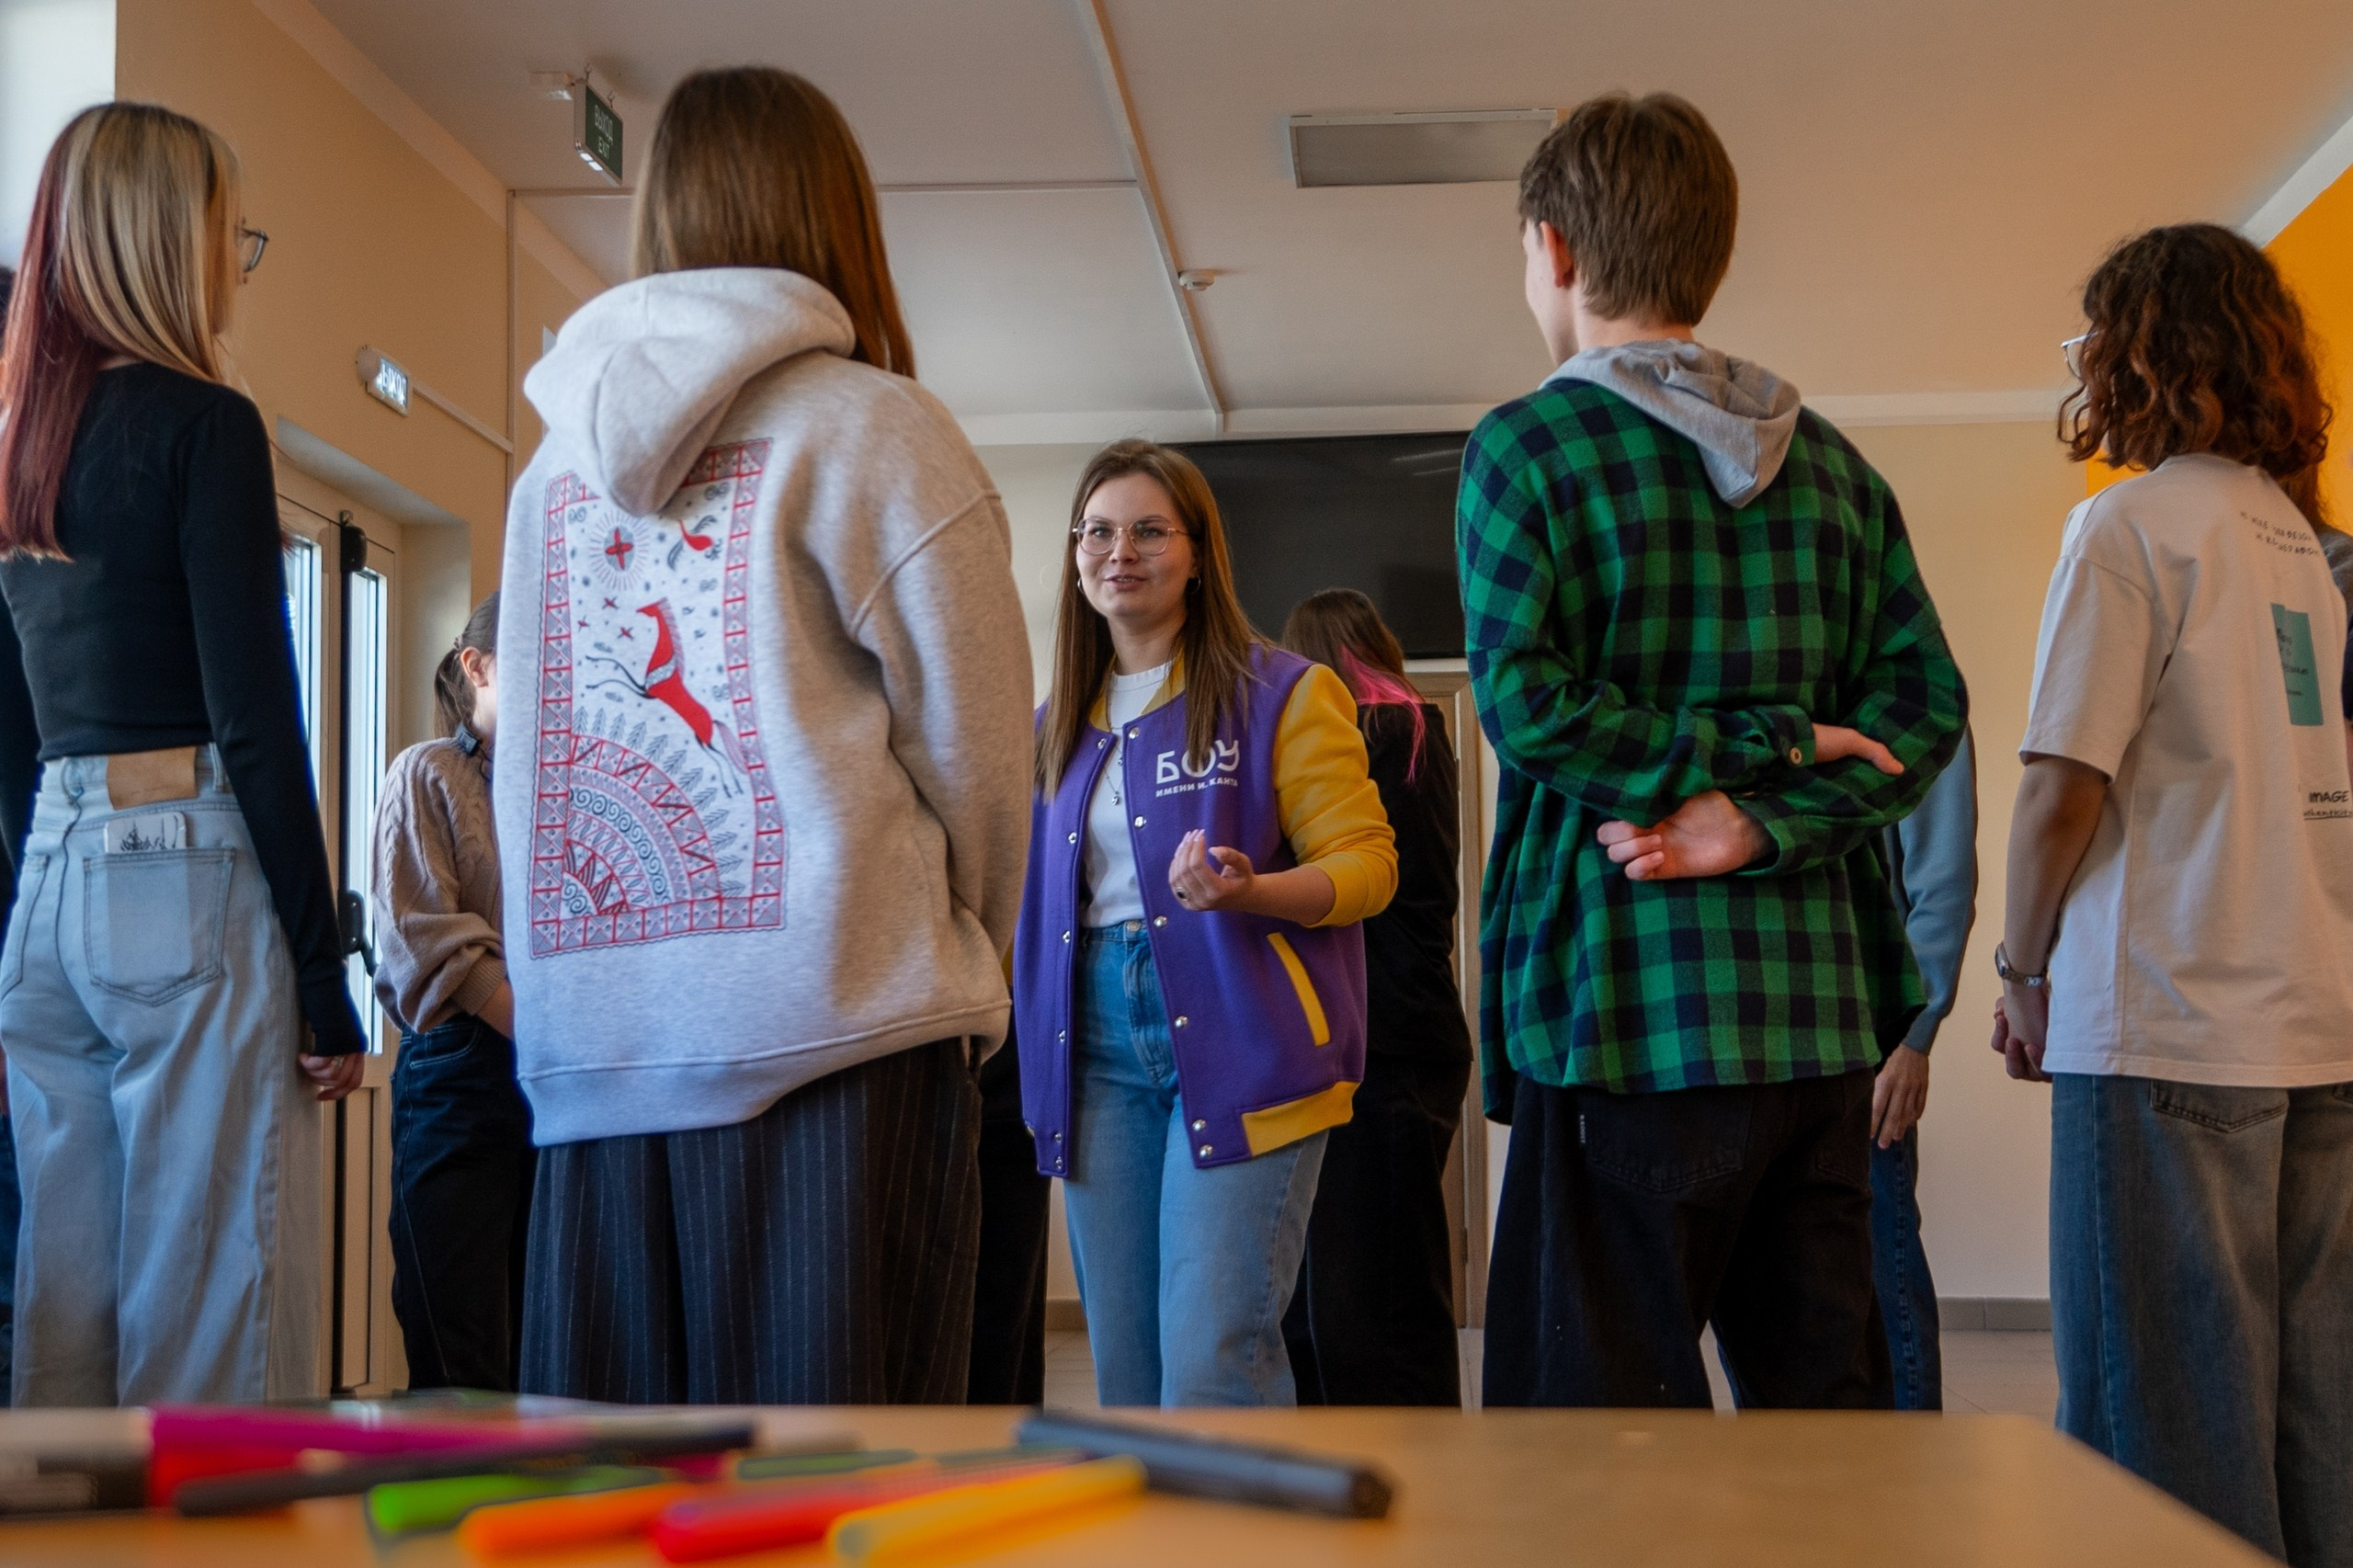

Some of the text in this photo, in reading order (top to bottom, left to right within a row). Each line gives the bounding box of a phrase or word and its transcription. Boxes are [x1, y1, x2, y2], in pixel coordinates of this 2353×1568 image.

[595, 104, 613, 146] ВЫХОД
[598, 135, 610, 159] EXIT
[1155, 777, 1238, 798] ИМЕНИ И. КАНТА
[2309, 790, 2349, 803] IMAGE
